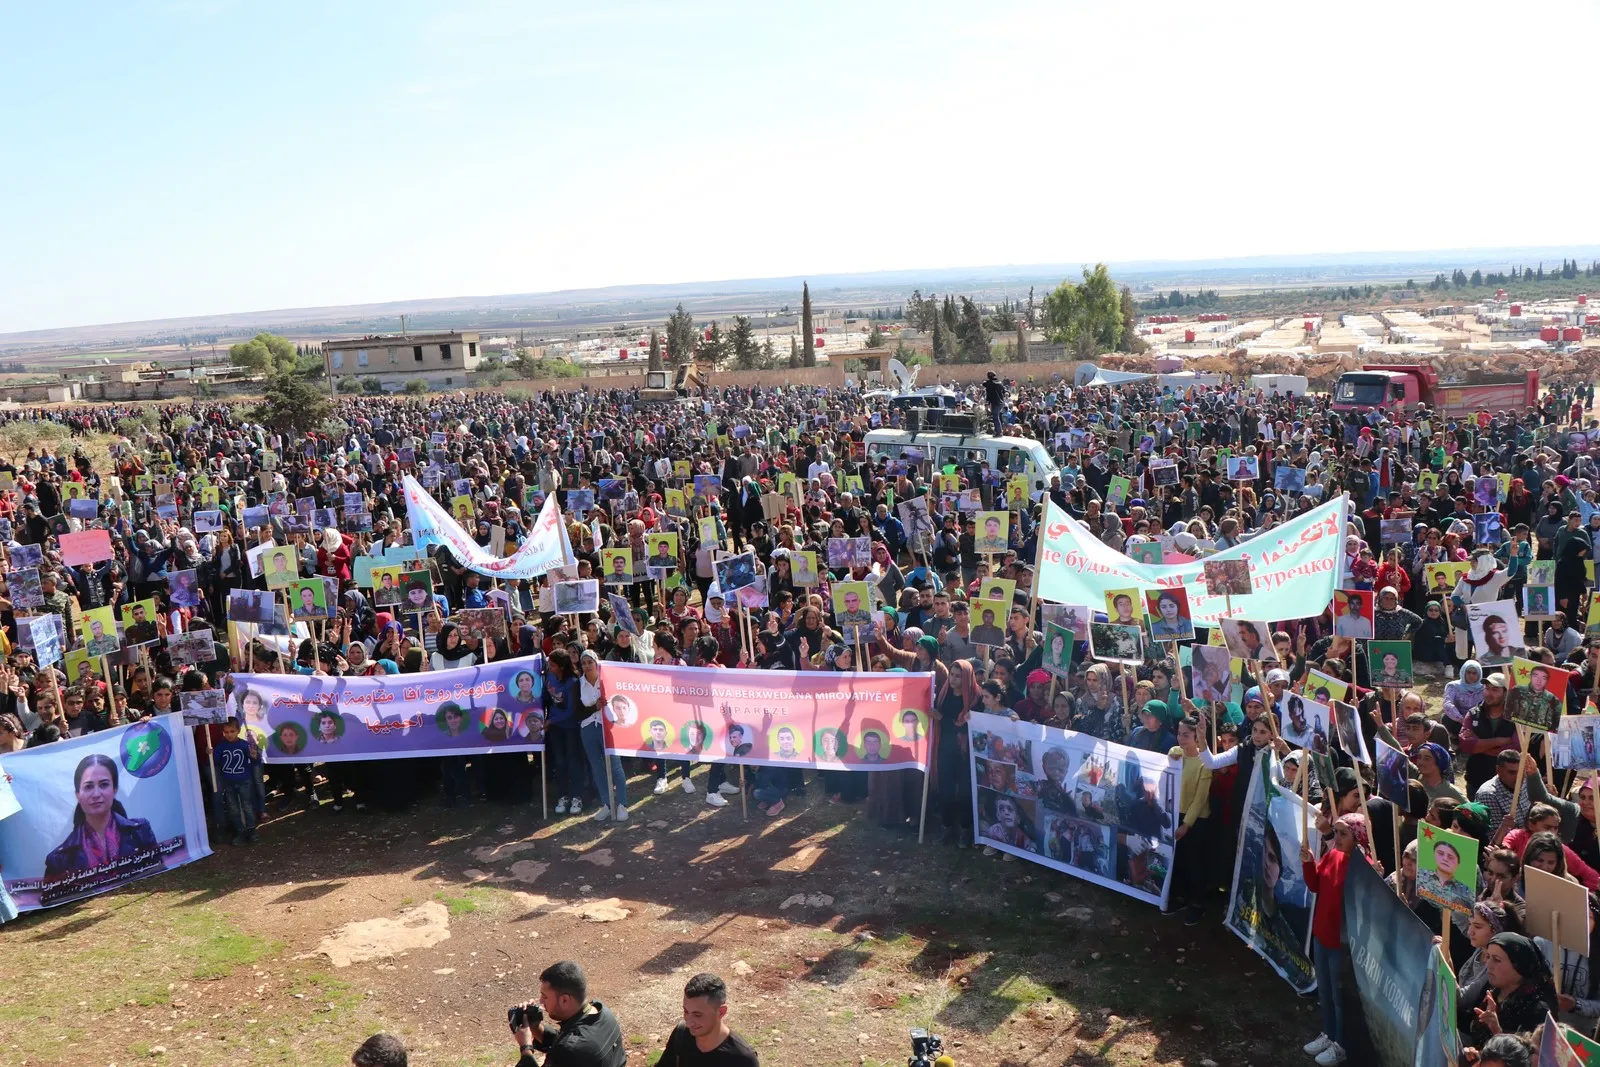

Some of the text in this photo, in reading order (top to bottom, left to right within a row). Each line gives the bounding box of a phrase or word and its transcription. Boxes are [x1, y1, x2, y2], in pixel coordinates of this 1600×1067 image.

[425, 688, 452, 704] روج
[453, 680, 505, 699] مقاومة
[616, 682, 687, 696] BERXWEDANA
[689, 686, 709, 696] ROJ
[711, 688, 733, 698] AVA
[735, 690, 812, 700] BERXWEDANA
[884, 692, 898, 702] YE
[344, 690, 394, 706] مقاومة
[222, 749, 245, 774] 22
[160, 838, 183, 854] الشهيدة
[118, 856, 133, 867] خلف
[77, 867, 97, 880] العامة
[120, 871, 131, 880] يوم
[41, 880, 61, 892] سوريا
